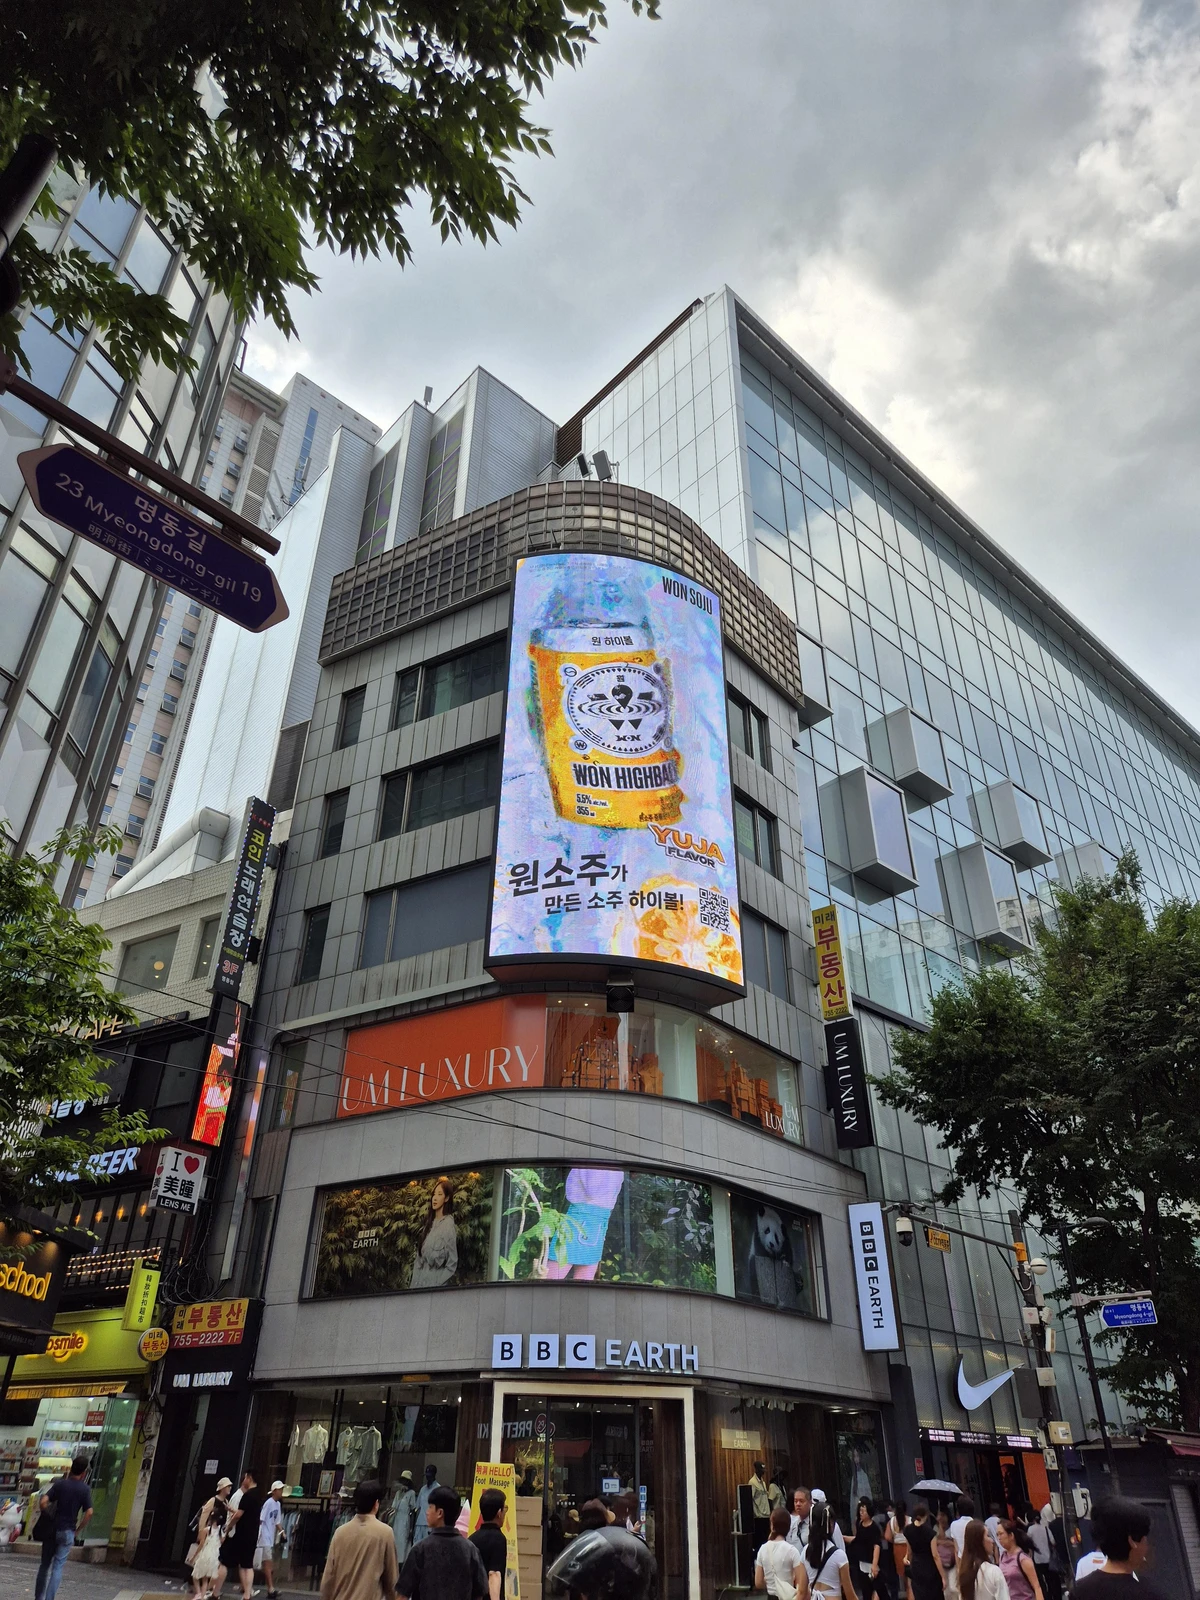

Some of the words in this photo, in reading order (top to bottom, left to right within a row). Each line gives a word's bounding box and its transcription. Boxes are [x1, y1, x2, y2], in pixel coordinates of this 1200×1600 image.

[134, 494, 207, 554] 명동길
[54, 472, 86, 498] 23
[85, 495, 236, 593] Myeongdong-gil
[242, 580, 262, 602] 19
[88, 524, 132, 554] 明洞街
[662, 576, 688, 601] WON
[689, 588, 714, 615] SOJU
[591, 636, 601, 646] 원
[604, 635, 634, 646] 하이볼
[573, 764, 612, 788] WON
[577, 793, 592, 805] 5.5%
[577, 806, 589, 816] 355
[652, 825, 725, 863] YUJA
[668, 847, 715, 867] FLAVOR
[508, 853, 629, 897] 원소주가
[544, 893, 582, 914] 만든
[587, 891, 624, 910] 소주
[629, 890, 684, 911] 하이볼!
[815, 910, 835, 925] 미래
[222, 960, 239, 975] 3F
[817, 925, 845, 1008] 부동산
[824, 1005, 848, 1017] 755-2222
[833, 1033, 850, 1061] UM
[342, 1069, 390, 1111] UM
[400, 1044, 539, 1102] LUXURY
[837, 1065, 858, 1132] LUXURY
[785, 1101, 800, 1122] UM
[765, 1111, 800, 1140] LUXURY
[171, 1151, 182, 1172] I
[162, 1175, 195, 1199] 美瞳
[160, 1198, 179, 1209] LENS
[180, 1203, 191, 1212] ME
[353, 1238, 379, 1249] EARTH
[861, 1223, 877, 1270] BBC
[868, 1276, 884, 1329] EARTH
[176, 1309, 186, 1330] 미래
[188, 1303, 242, 1329] 부동산
[142, 1339, 168, 1351] 부동산
[148, 1331, 163, 1340] 미래
[174, 1332, 225, 1346] 755-2222
[228, 1331, 241, 1343] 7F
[496, 1338, 592, 1364] BBC
[605, 1339, 698, 1371] EARTH
[173, 1373, 190, 1387] UM
[192, 1371, 233, 1387] LUXURY
[489, 1465, 511, 1477] HELLO
[474, 1476, 486, 1484] Foot
[489, 1477, 510, 1489] Massage
